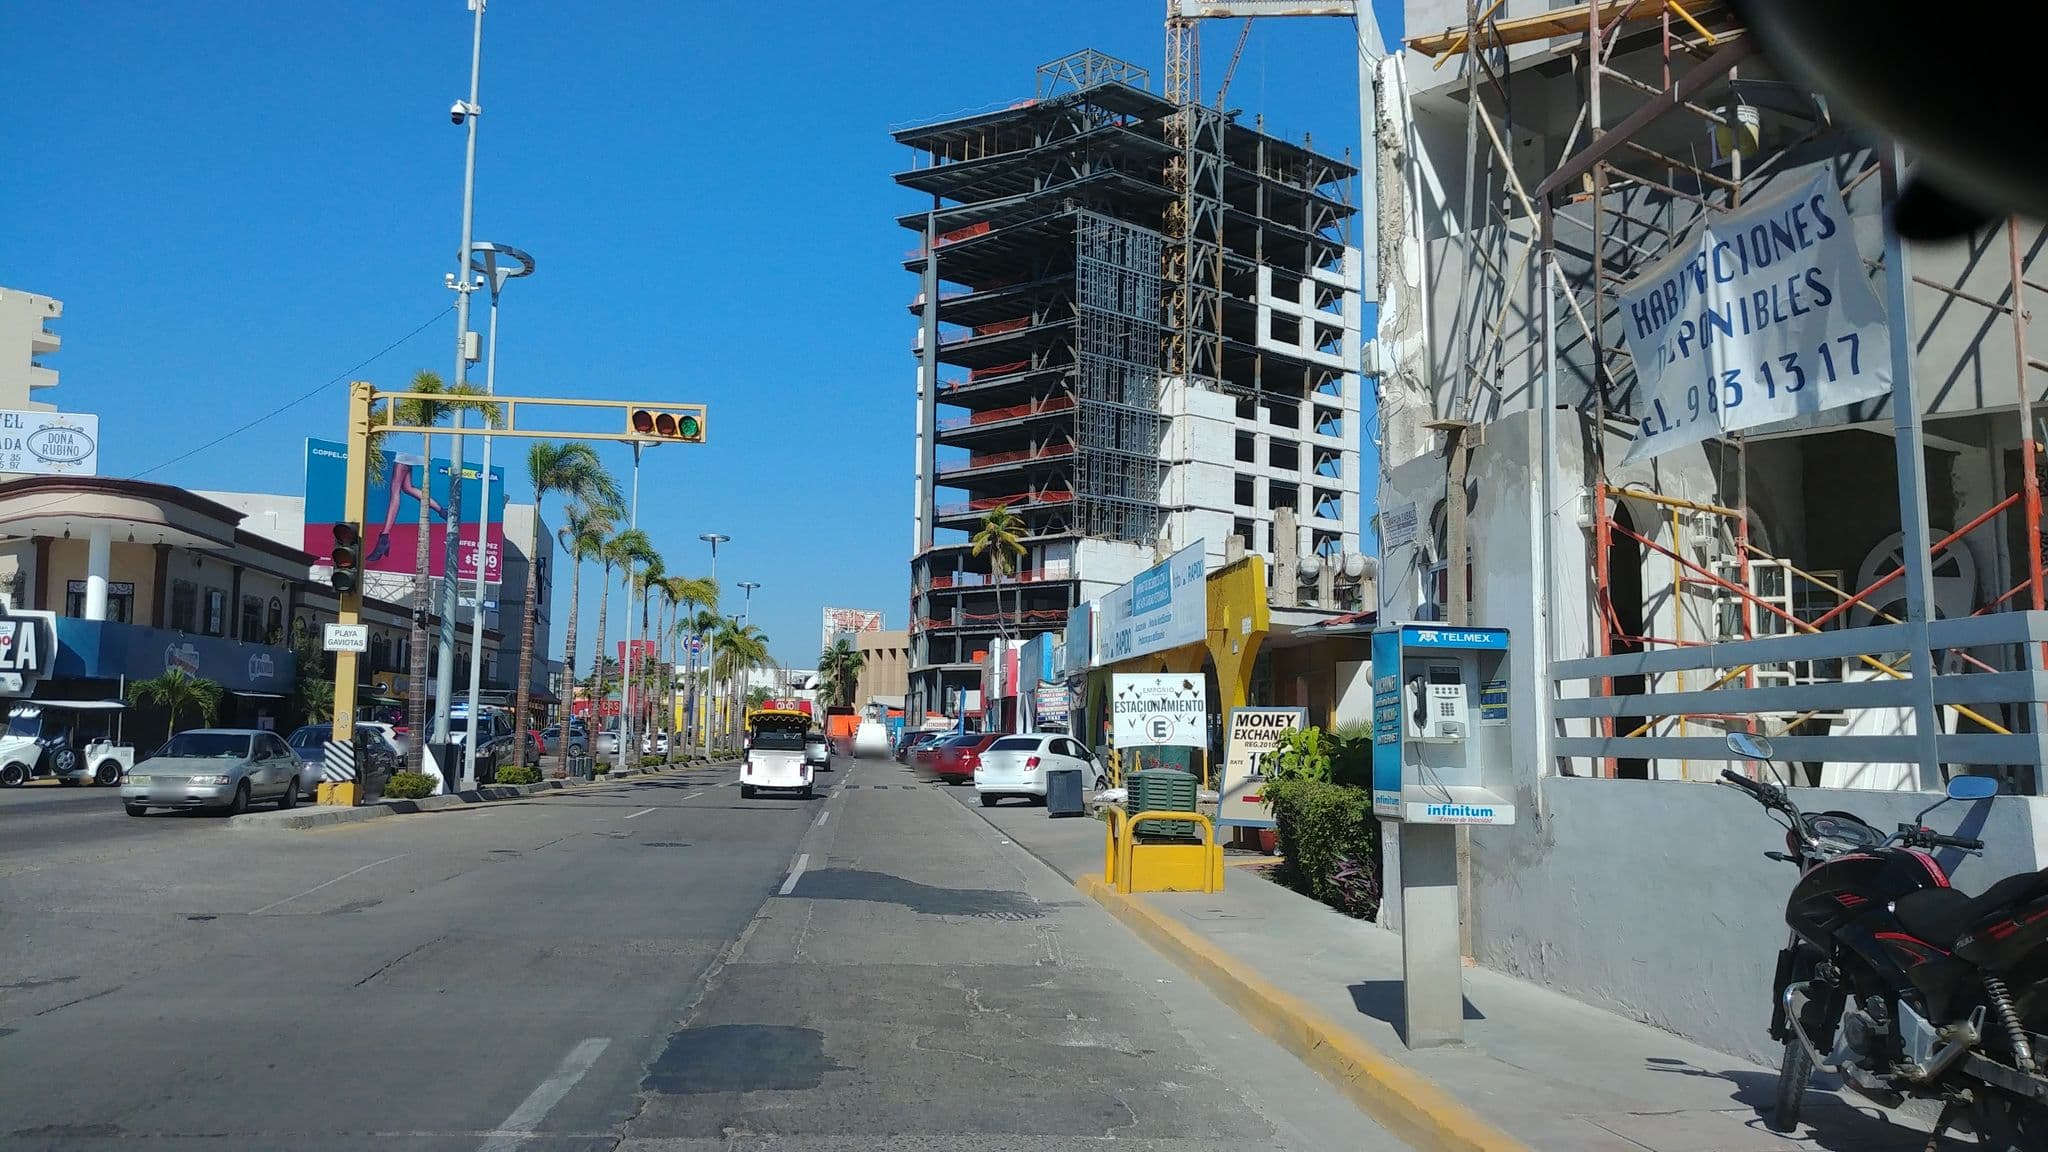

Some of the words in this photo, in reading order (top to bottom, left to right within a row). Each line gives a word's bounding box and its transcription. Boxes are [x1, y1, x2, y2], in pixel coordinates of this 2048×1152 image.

[1656, 267, 1832, 384] DPONIBLES
[1634, 398, 1681, 440] EL.
[1687, 368, 1743, 423] 983
[0, 413, 23, 429] EL
[0, 437, 21, 451] DA
[48, 431, 74, 444] DOÑA
[42, 444, 79, 456] RUBINO
[465, 553, 497, 568] $59
[1441, 632, 1490, 643] TELMEX
[1114, 699, 1204, 713] ESTACIONAMIENTO
[1235, 714, 1296, 727] MONEY
[1153, 721, 1166, 737] E
[1234, 729, 1281, 740] EXCHAN
[1427, 804, 1493, 817] infinitum
